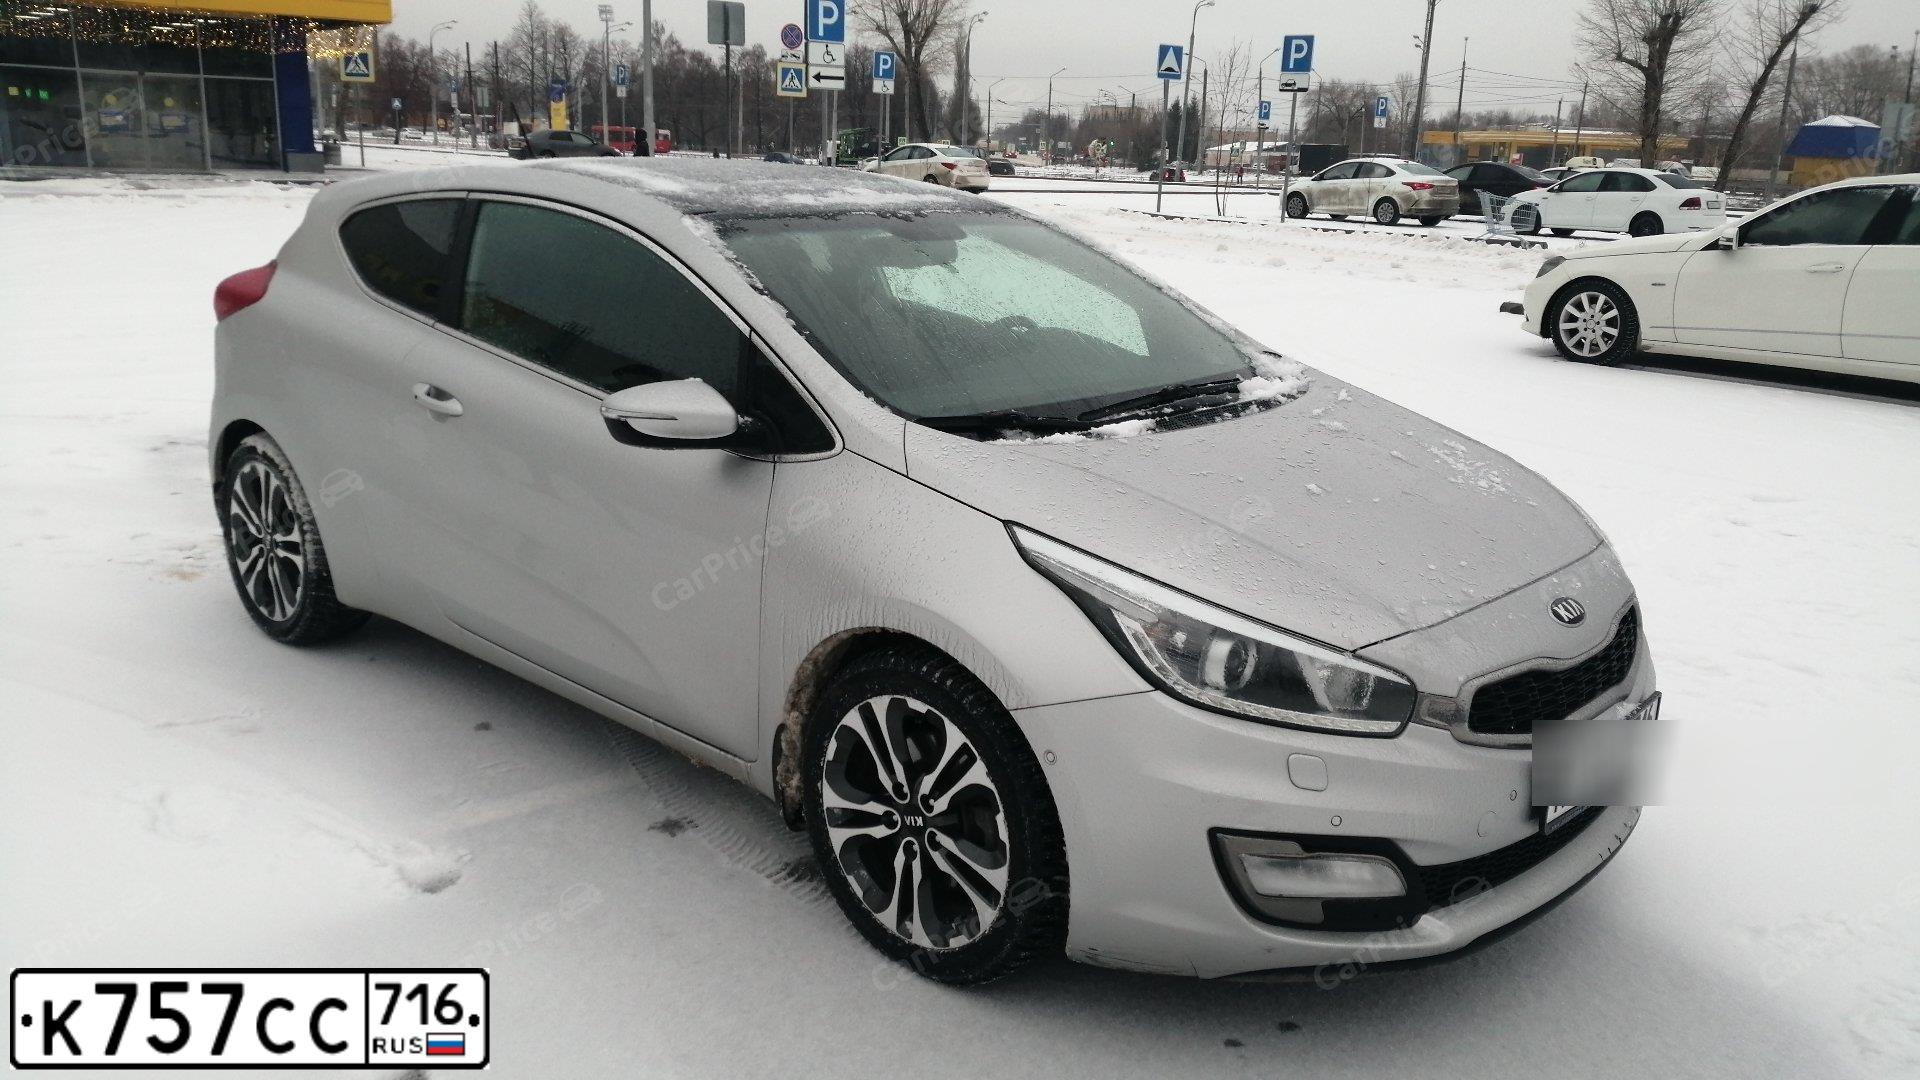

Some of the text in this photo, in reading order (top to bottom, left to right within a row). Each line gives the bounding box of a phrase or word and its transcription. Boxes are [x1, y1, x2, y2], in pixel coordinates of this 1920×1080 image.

[819, 1, 839, 36] P
[1289, 38, 1309, 69] P
[880, 54, 892, 77] P
[1261, 102, 1269, 118] P
[1378, 98, 1387, 115] P
[1552, 599, 1585, 622] KIA
